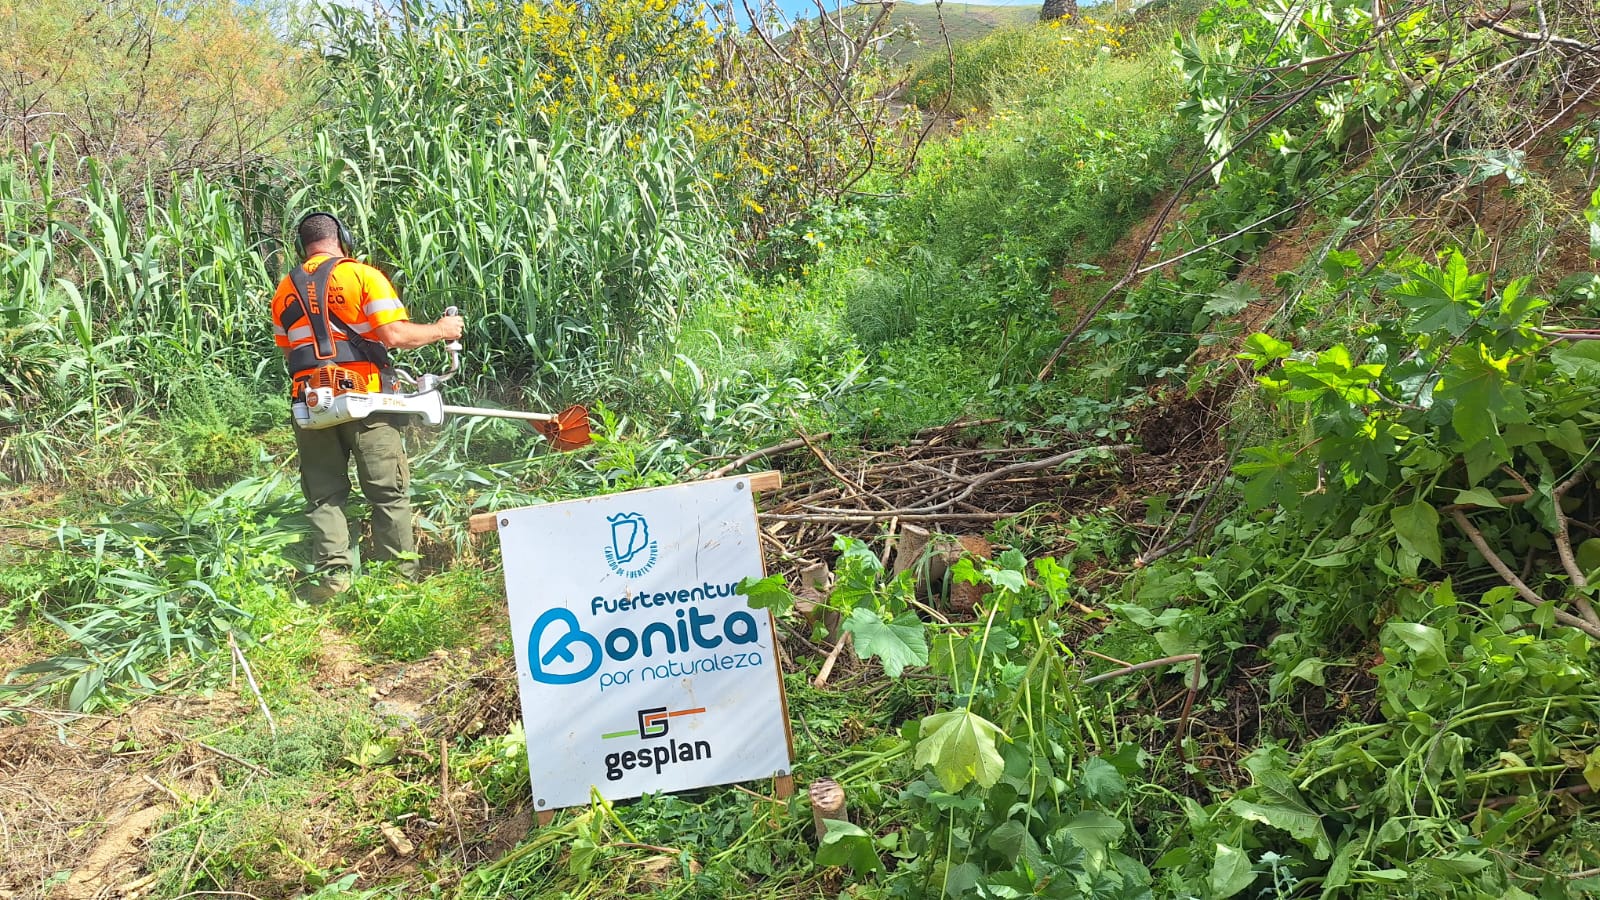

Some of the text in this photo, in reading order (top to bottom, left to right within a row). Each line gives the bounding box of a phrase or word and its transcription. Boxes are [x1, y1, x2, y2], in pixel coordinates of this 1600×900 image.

[306, 281, 320, 314] STIHL
[626, 540, 658, 578] FUERTEVENTURA
[591, 582, 740, 615] Fuerteventur
[600, 652, 762, 691] por naturaleza
[605, 739, 712, 781] gesplan
